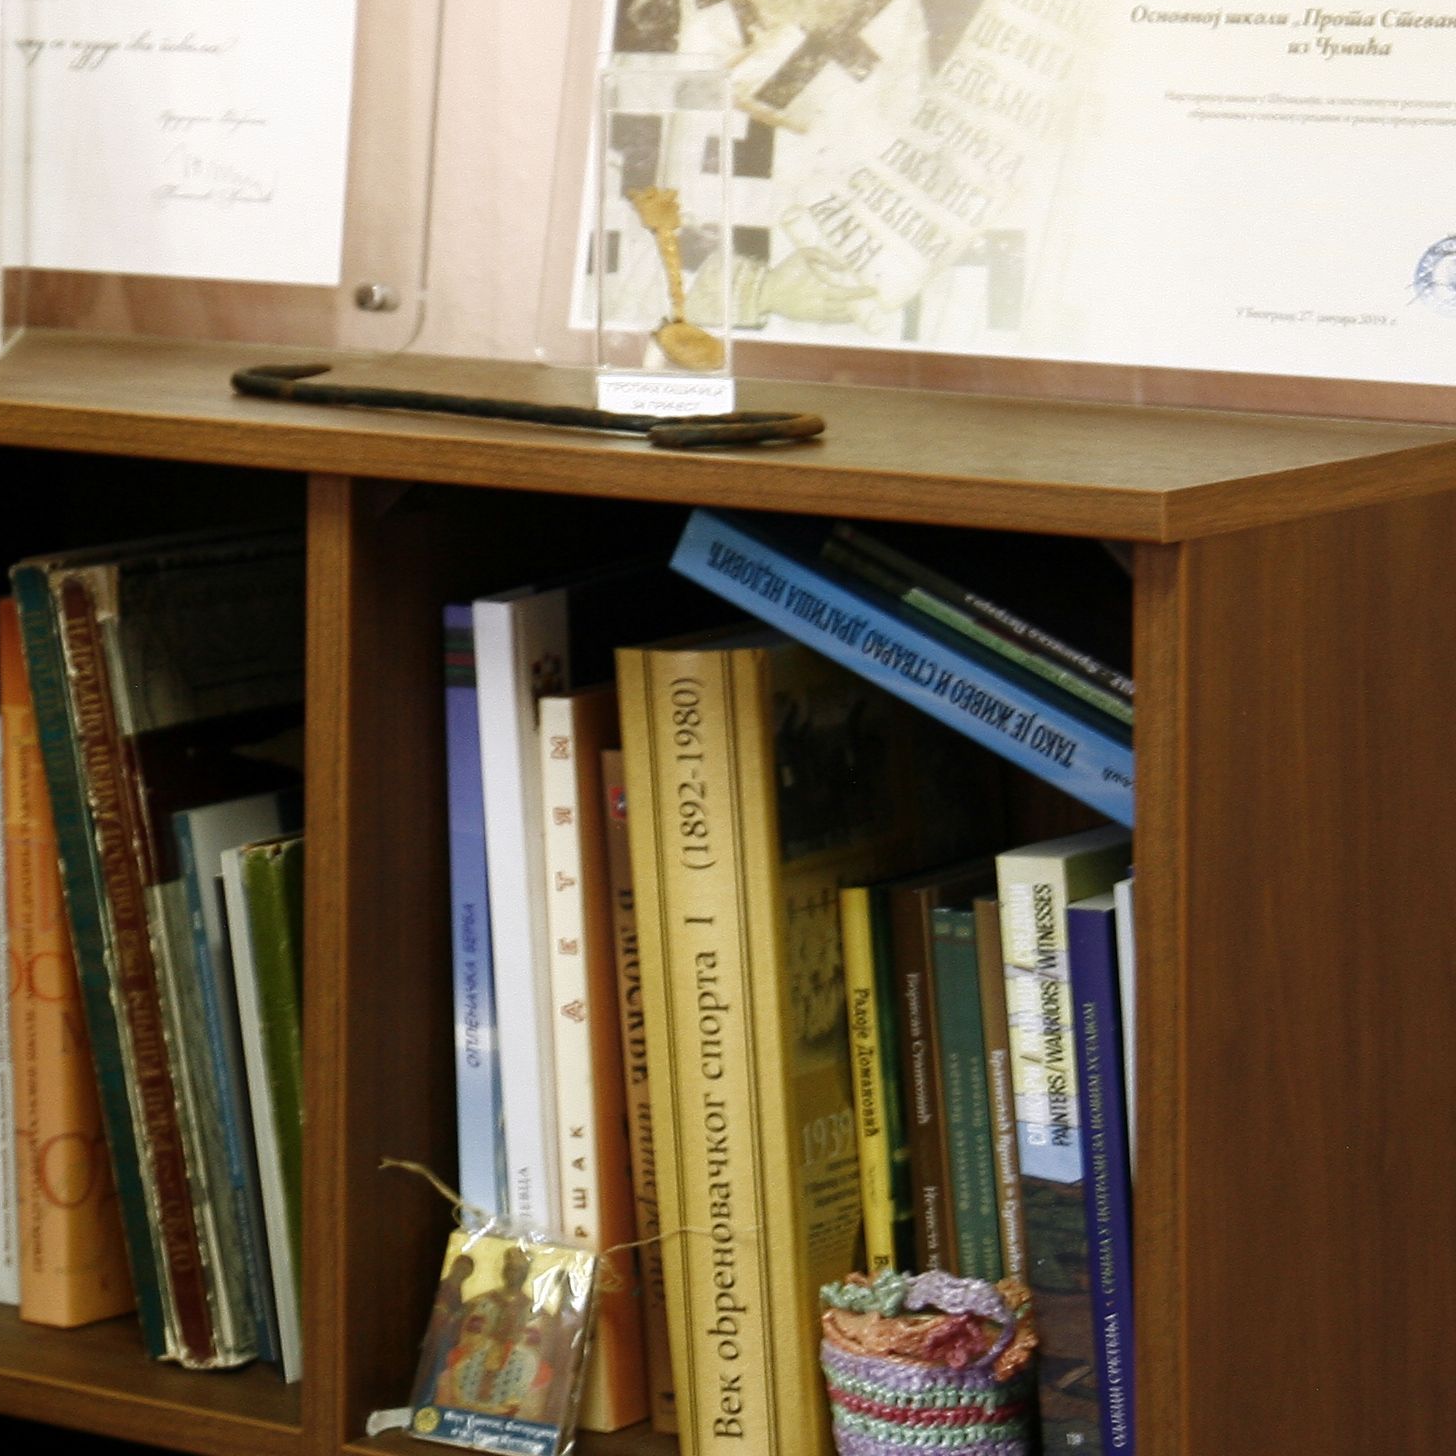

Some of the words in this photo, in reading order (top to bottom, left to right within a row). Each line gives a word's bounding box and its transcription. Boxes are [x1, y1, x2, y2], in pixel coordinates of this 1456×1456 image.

[709, 540, 787, 605] НЕДОВИЋ
[786, 588, 867, 647] ДРАГИША
[861, 629, 937, 686] СТВАРАО
[932, 668, 949, 694] И
[950, 677, 1014, 733] ЖИВЕО
[1011, 711, 1036, 742] ЈЕ
[670, 676, 717, 871] (1892-1980)
[1031, 730, 1078, 769] ТАКО
[694, 949, 730, 1082] спорта
[851, 988, 872, 1041] Радоје
[856, 1043, 881, 1138] Домановић
[712, 1373, 744, 1441] Век
